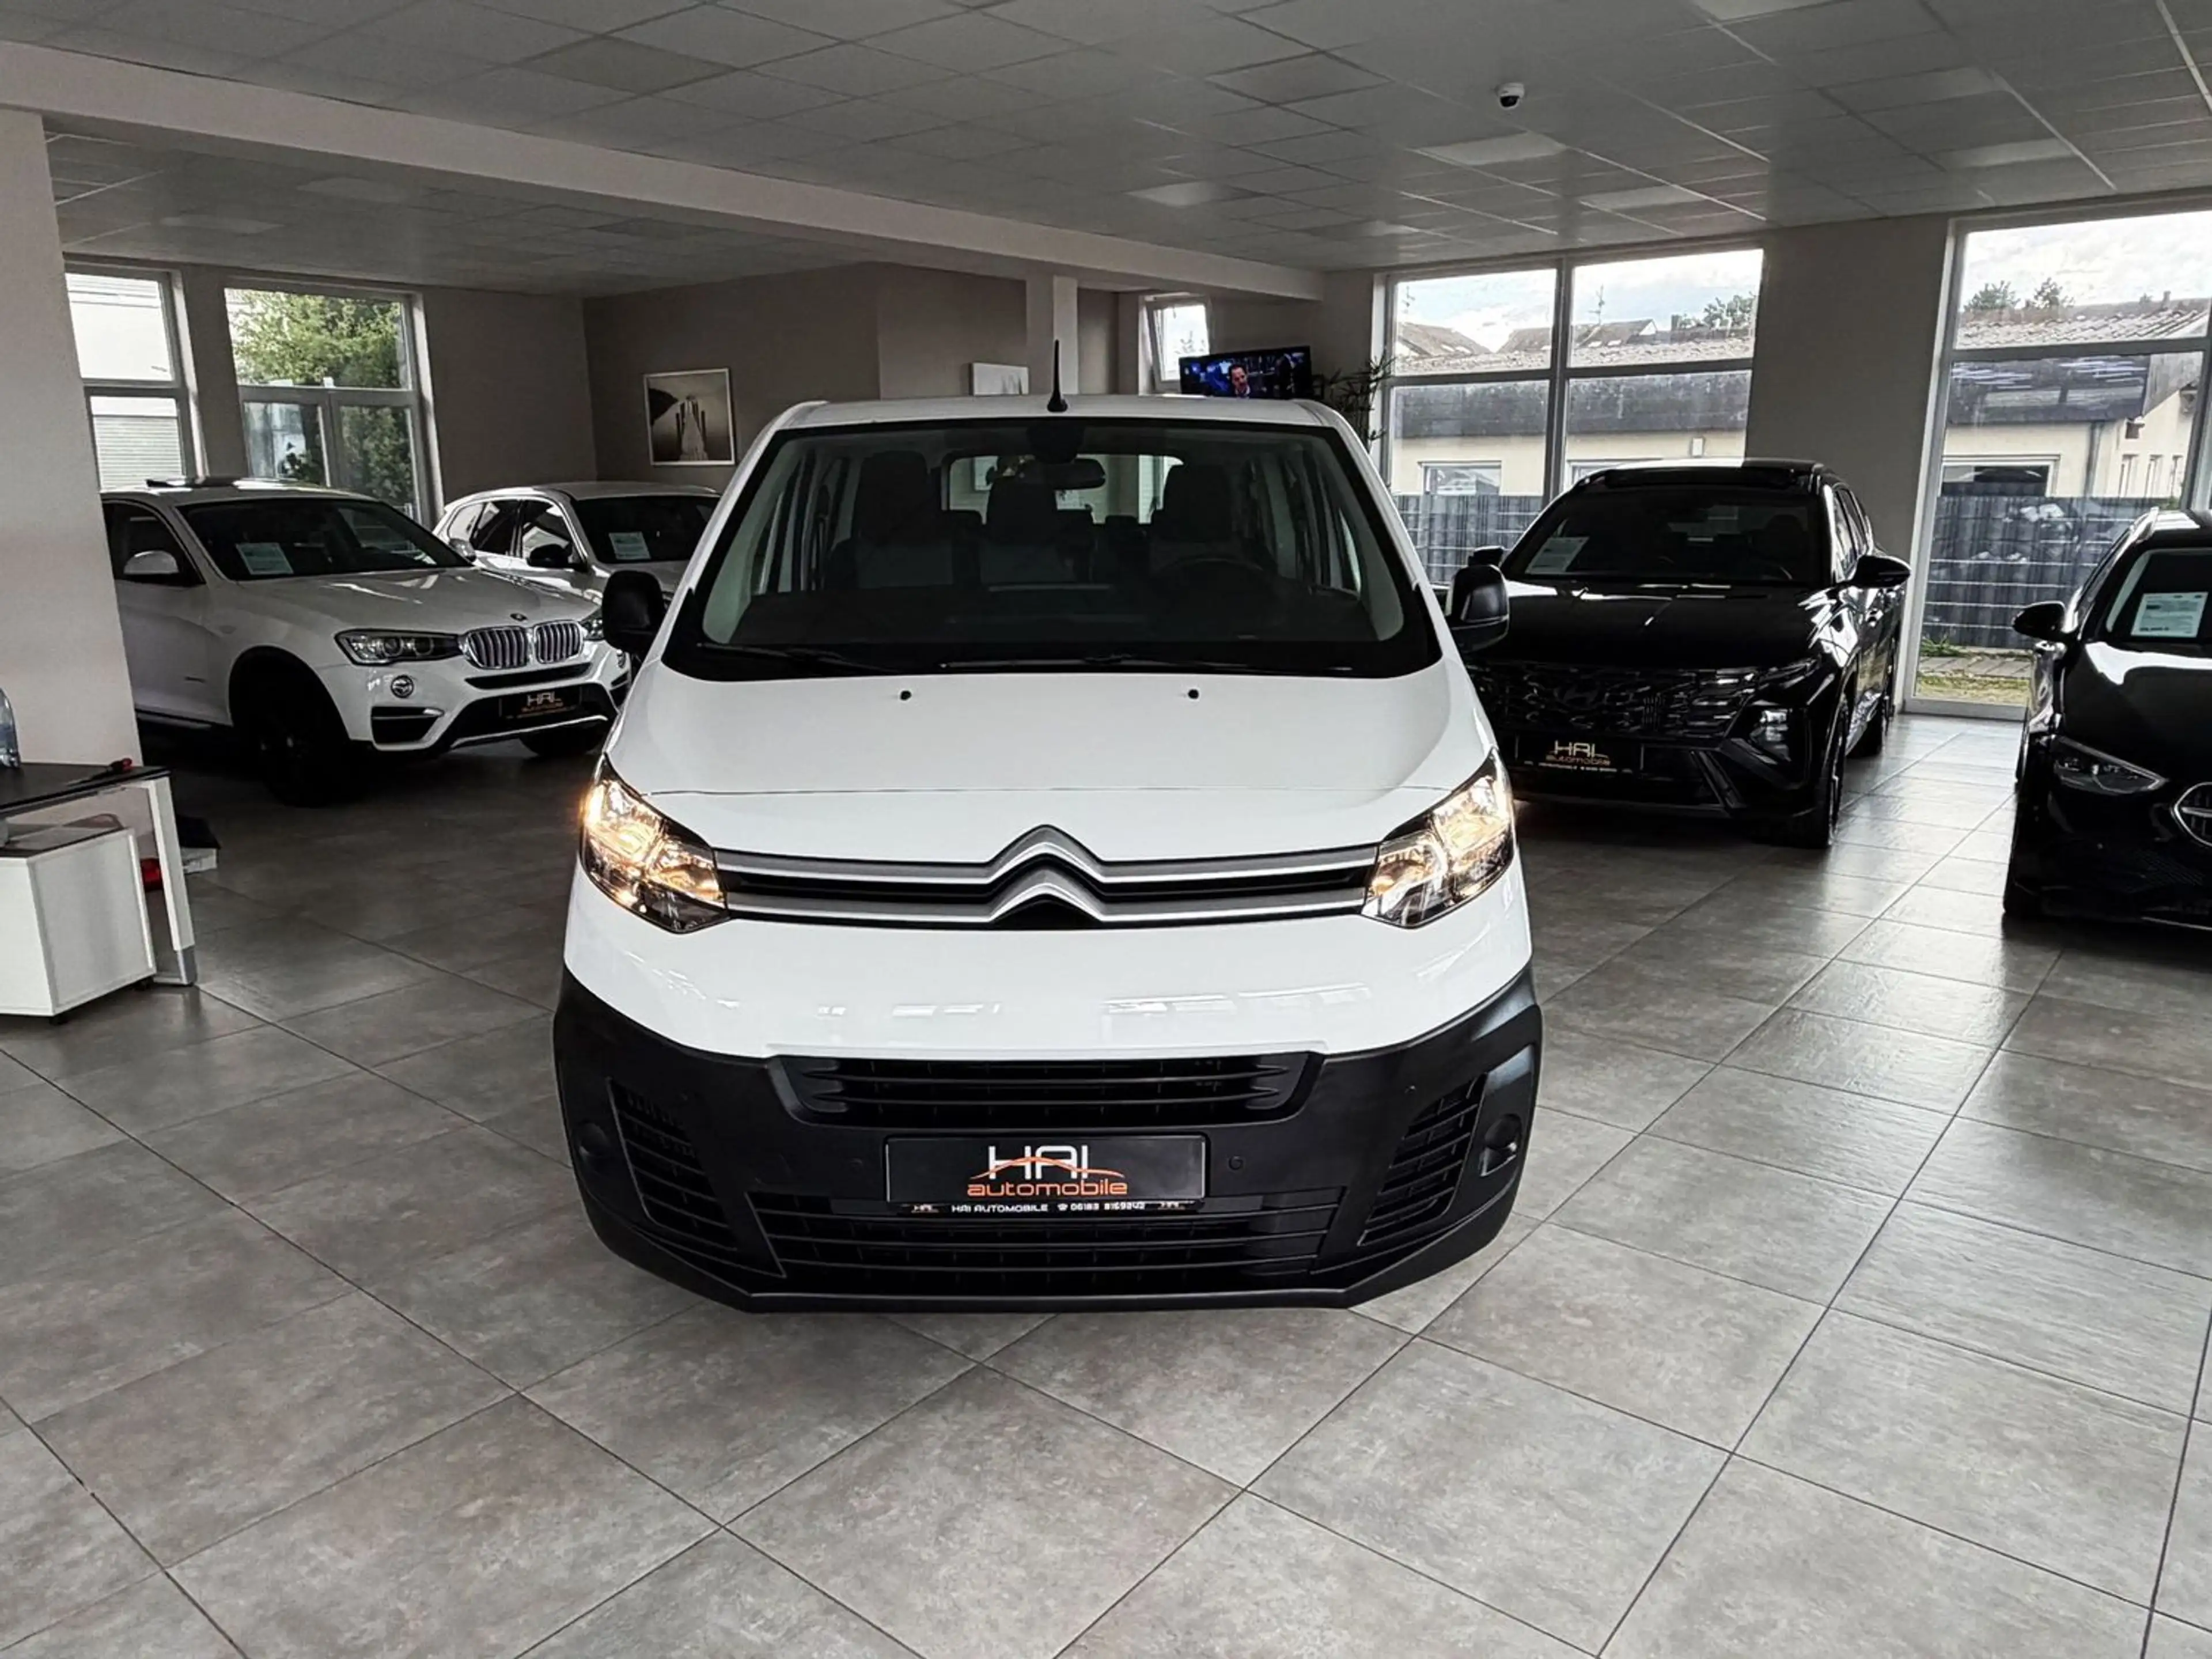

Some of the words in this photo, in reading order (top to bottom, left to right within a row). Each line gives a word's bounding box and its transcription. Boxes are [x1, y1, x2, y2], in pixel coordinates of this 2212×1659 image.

[1554, 740, 1595, 757] HAI
[988, 1145, 1088, 1179] HAI
[967, 1178, 1127, 1196] automobile
[952, 1204, 971, 1213] HAI
[974, 1204, 1048, 1213] AUTOMOBILE
